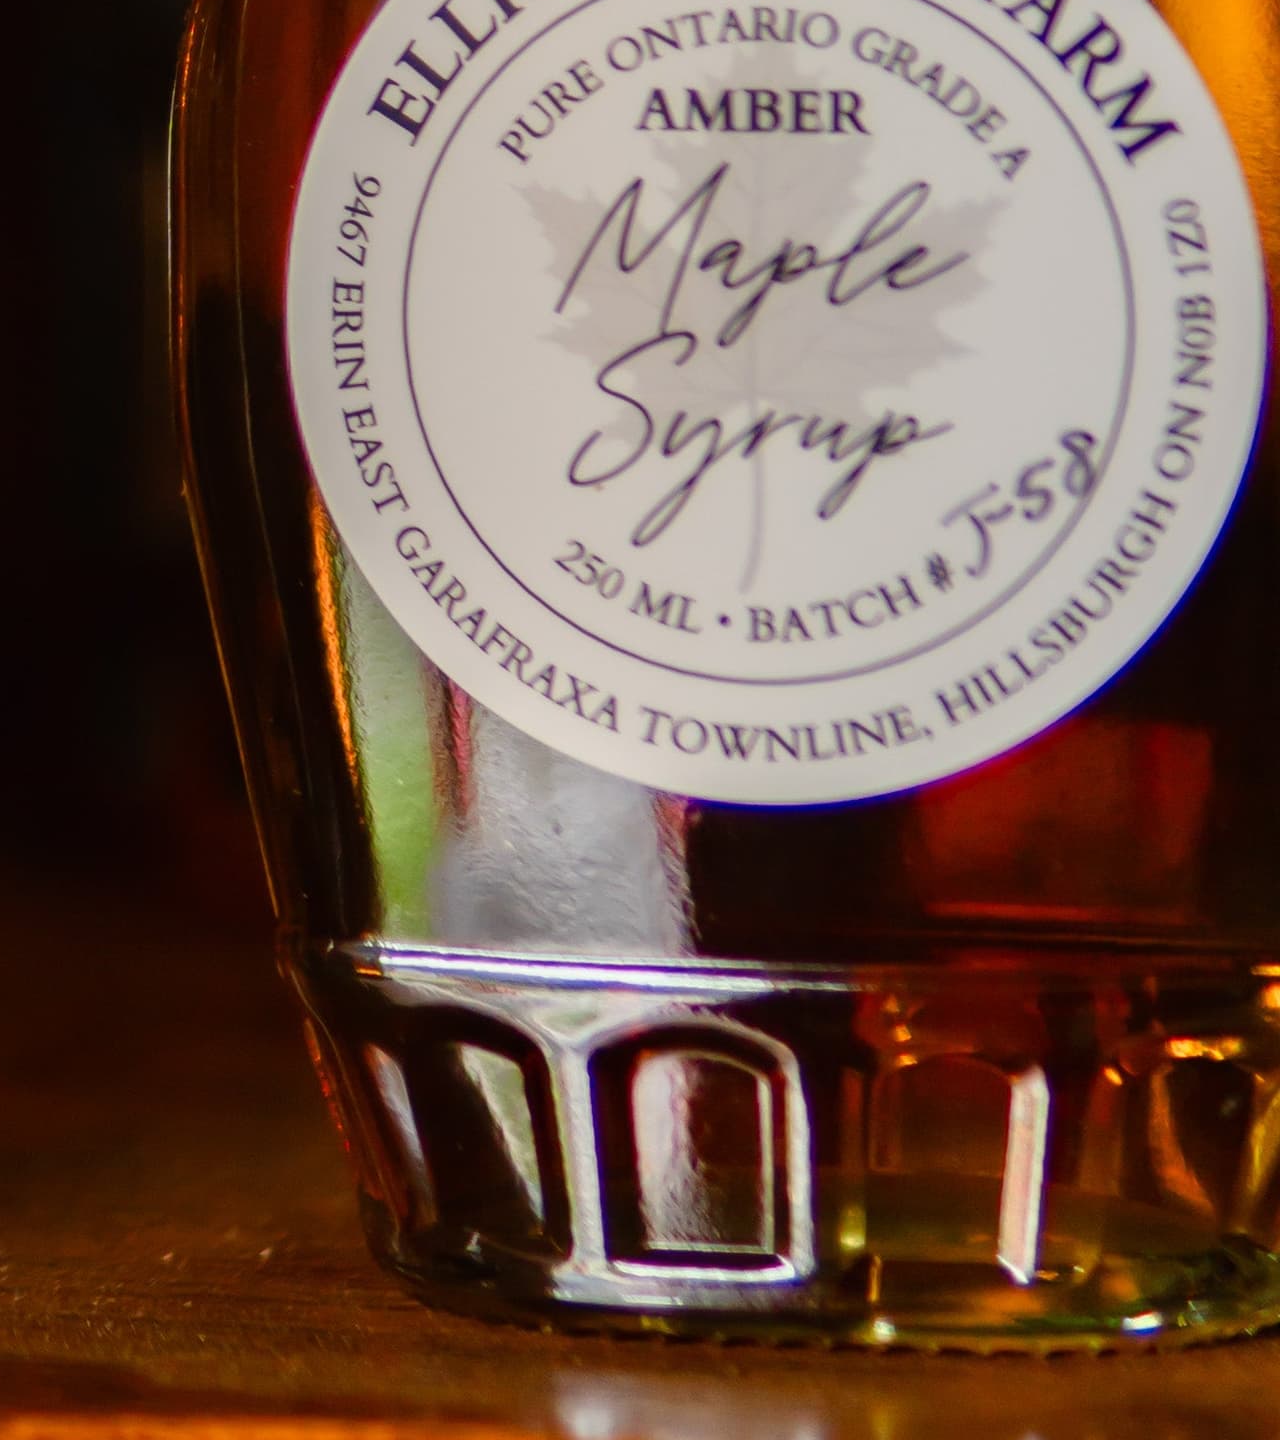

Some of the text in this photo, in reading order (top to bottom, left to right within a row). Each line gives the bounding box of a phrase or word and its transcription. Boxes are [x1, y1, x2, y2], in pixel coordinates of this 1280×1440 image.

[497, 6, 1031, 181] PURE ONTARIO GRADE A
[634, 87, 872, 136] AMBER
[336, 172, 382, 268] 9467
[553, 161, 969, 350] Maple
[331, 278, 370, 391] ERIN
[341, 404, 411, 514] EAST
[565, 329, 953, 549] Syrup
[1154, 401, 1205, 482] ON
[394, 524, 620, 733] GARAFRAXA
[553, 539, 625, 600] 250
[628, 581, 700, 635] ML
[747, 574, 923, 643] BATCH
[934, 489, 1177, 726] HILLSBURGH
[640, 705, 934, 762] TOWNLINE,
